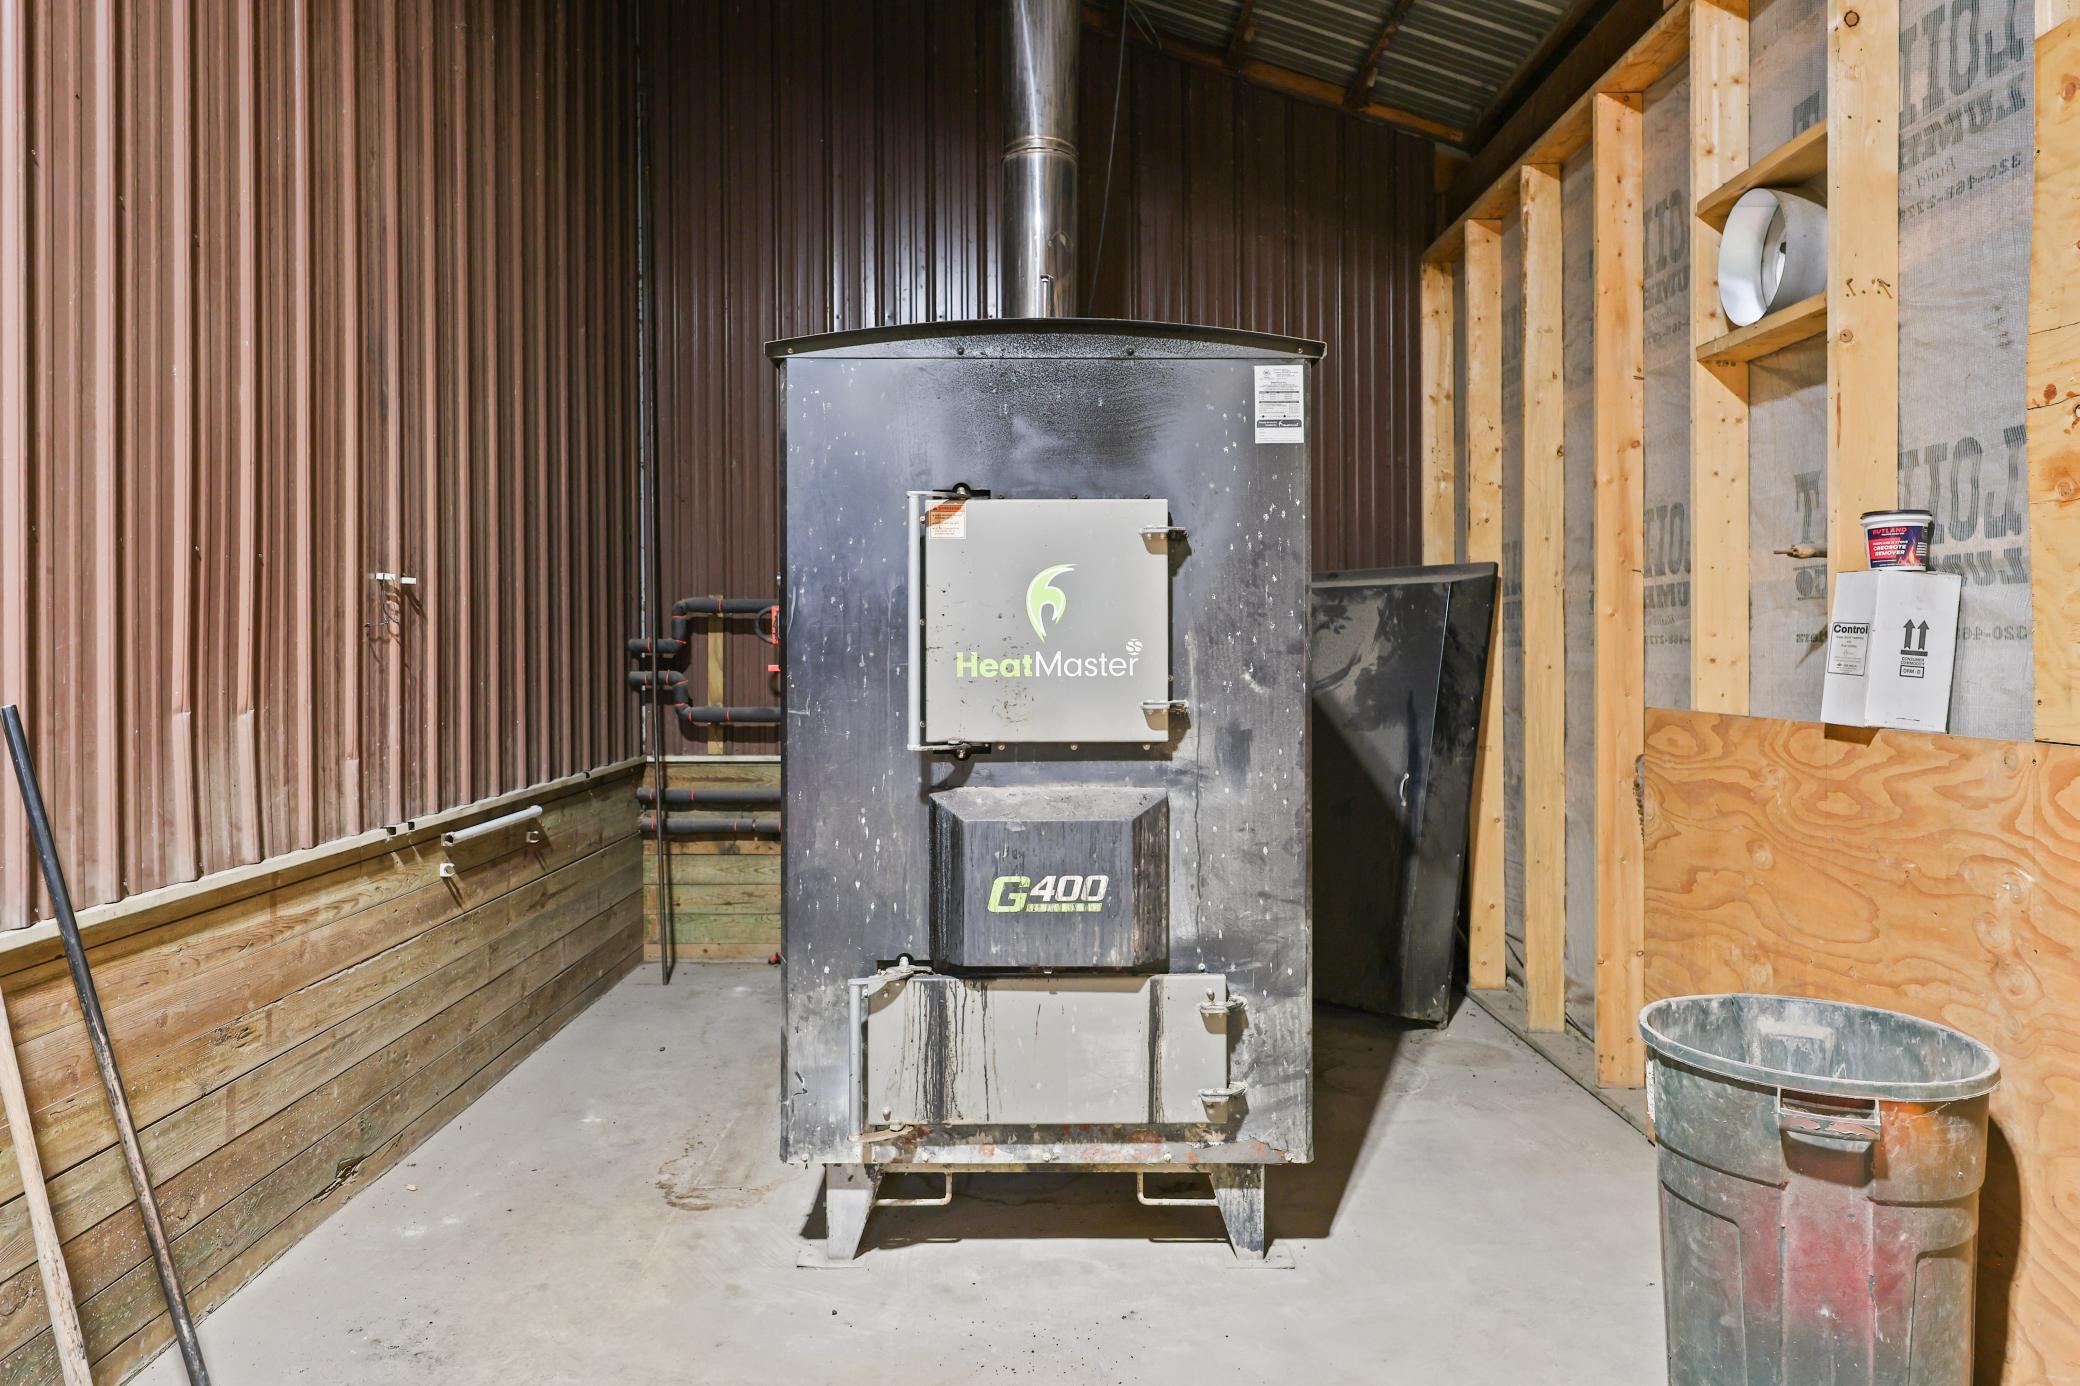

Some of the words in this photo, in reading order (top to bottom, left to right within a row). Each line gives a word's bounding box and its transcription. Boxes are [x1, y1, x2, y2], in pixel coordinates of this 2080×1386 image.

[1872, 527, 1908, 535] RUTLAND
[1833, 624, 1869, 634] Control
[956, 651, 1138, 677] HeatMaster
[987, 875, 1109, 913] G400
